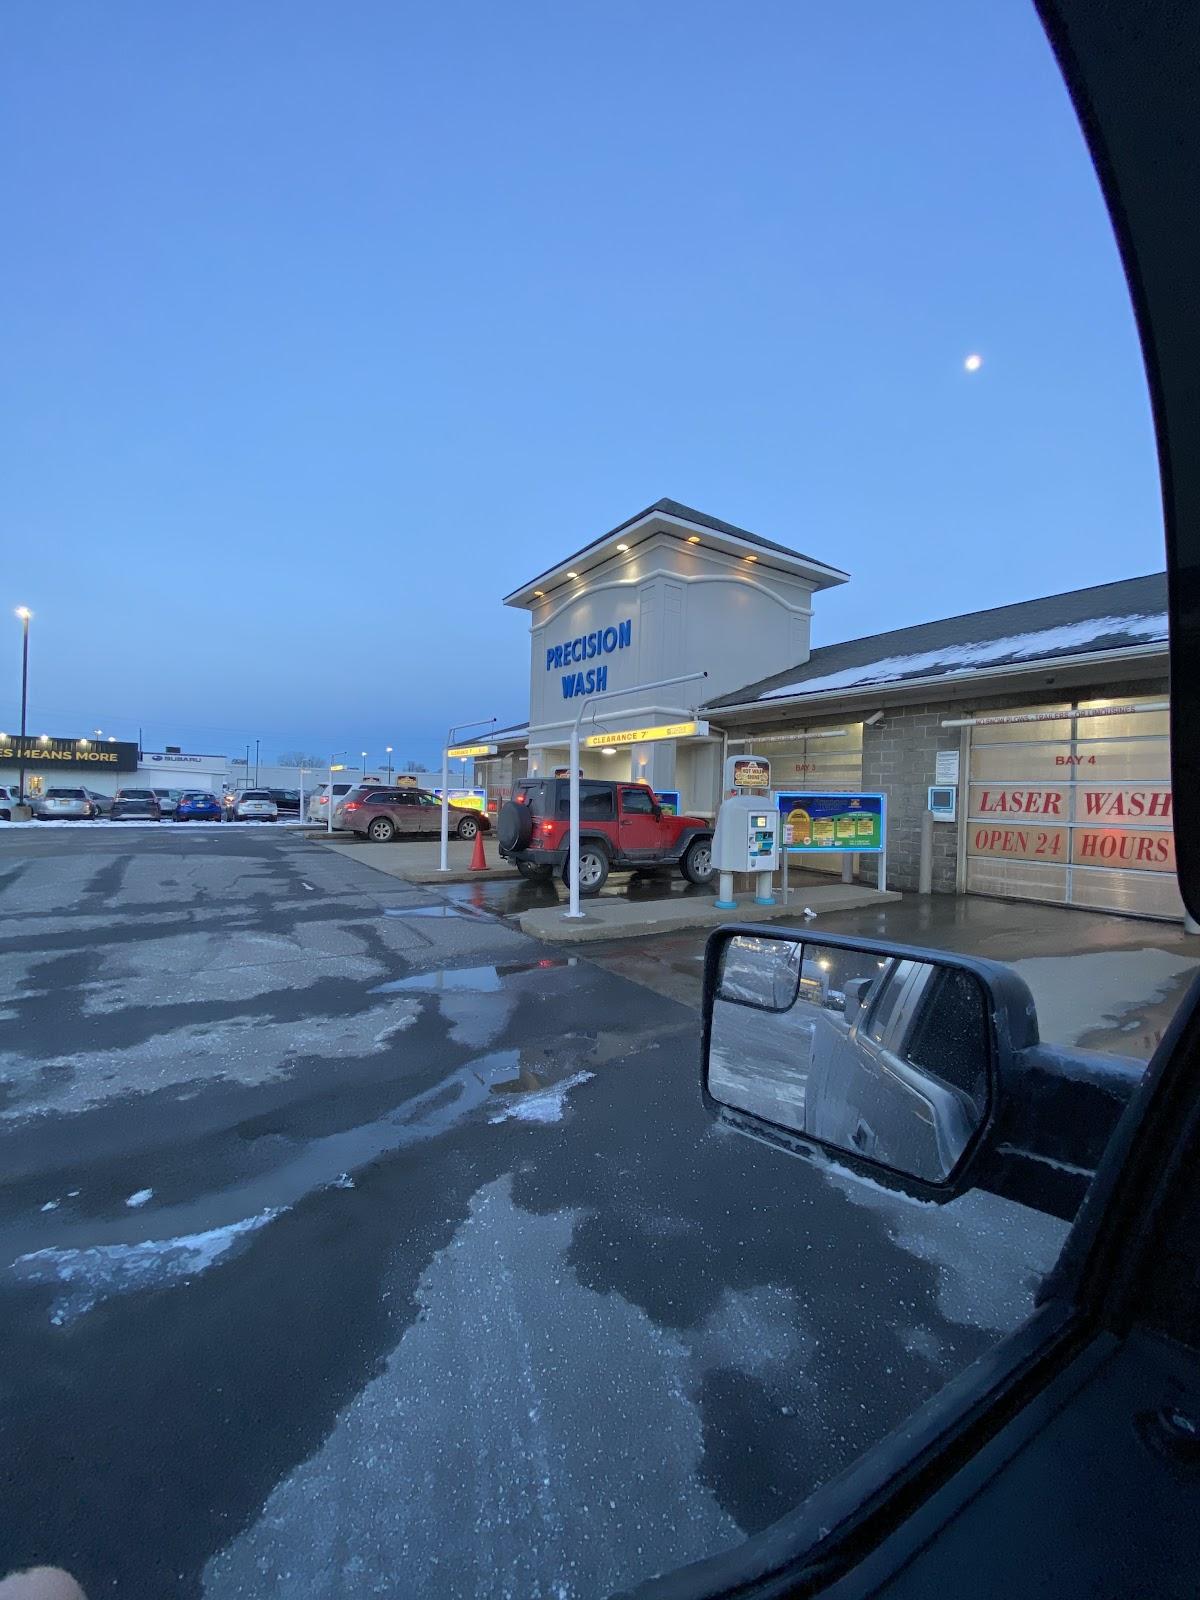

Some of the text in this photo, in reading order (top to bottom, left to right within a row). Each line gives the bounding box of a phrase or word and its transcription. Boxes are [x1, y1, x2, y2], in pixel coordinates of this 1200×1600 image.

[546, 619, 631, 671] PRECISION
[562, 665, 608, 699] WASH
[1007, 715, 1030, 724] PLOWS
[1036, 712, 1069, 722] TRAILERS
[1075, 710, 1086, 719] OR
[1088, 706, 1137, 717] LIMOUSINES
[593, 733, 638, 745] CLEARANCE
[17, 749, 72, 760] MEANS
[76, 751, 118, 762] MORE
[1055, 755, 1096, 766] BAY 4
[795, 764, 811, 772] BAY
[979, 791, 1171, 817] LASER WASH
[975, 829, 1169, 863] OPEN 24 HOURS
